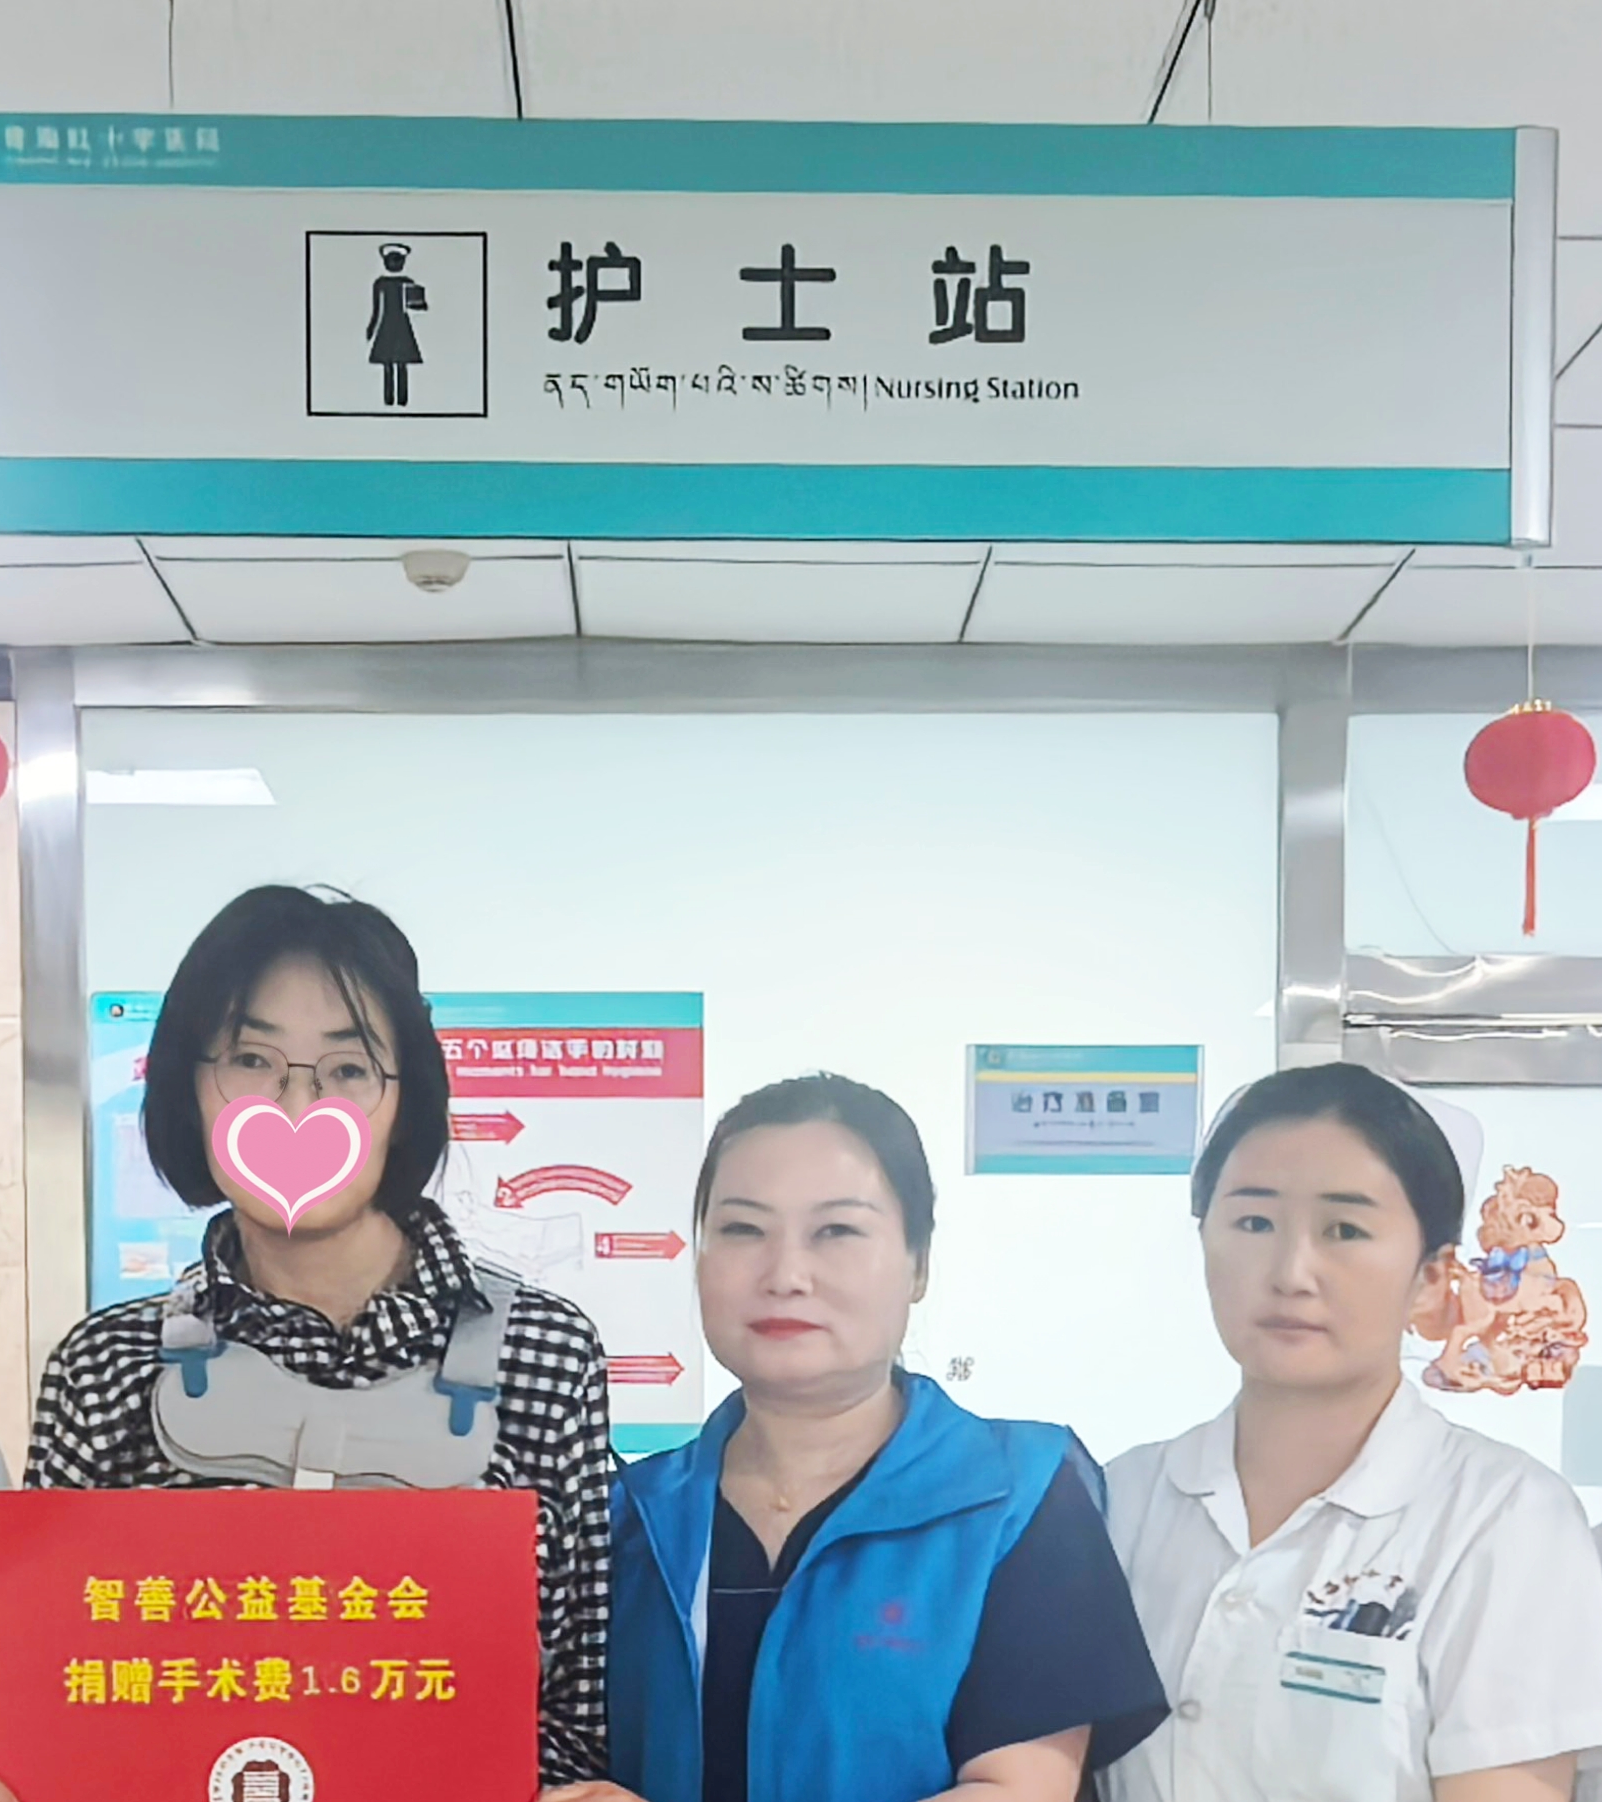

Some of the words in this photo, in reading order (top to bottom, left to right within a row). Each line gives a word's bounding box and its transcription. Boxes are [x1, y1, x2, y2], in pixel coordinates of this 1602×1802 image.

[546, 241, 1031, 345] 护士站
[875, 375, 980, 403] Nursing
[986, 376, 1080, 400] Station
[82, 1575, 429, 1623] 智善公益基金会
[63, 1657, 457, 1705] 捐赠手术费1.6万元
